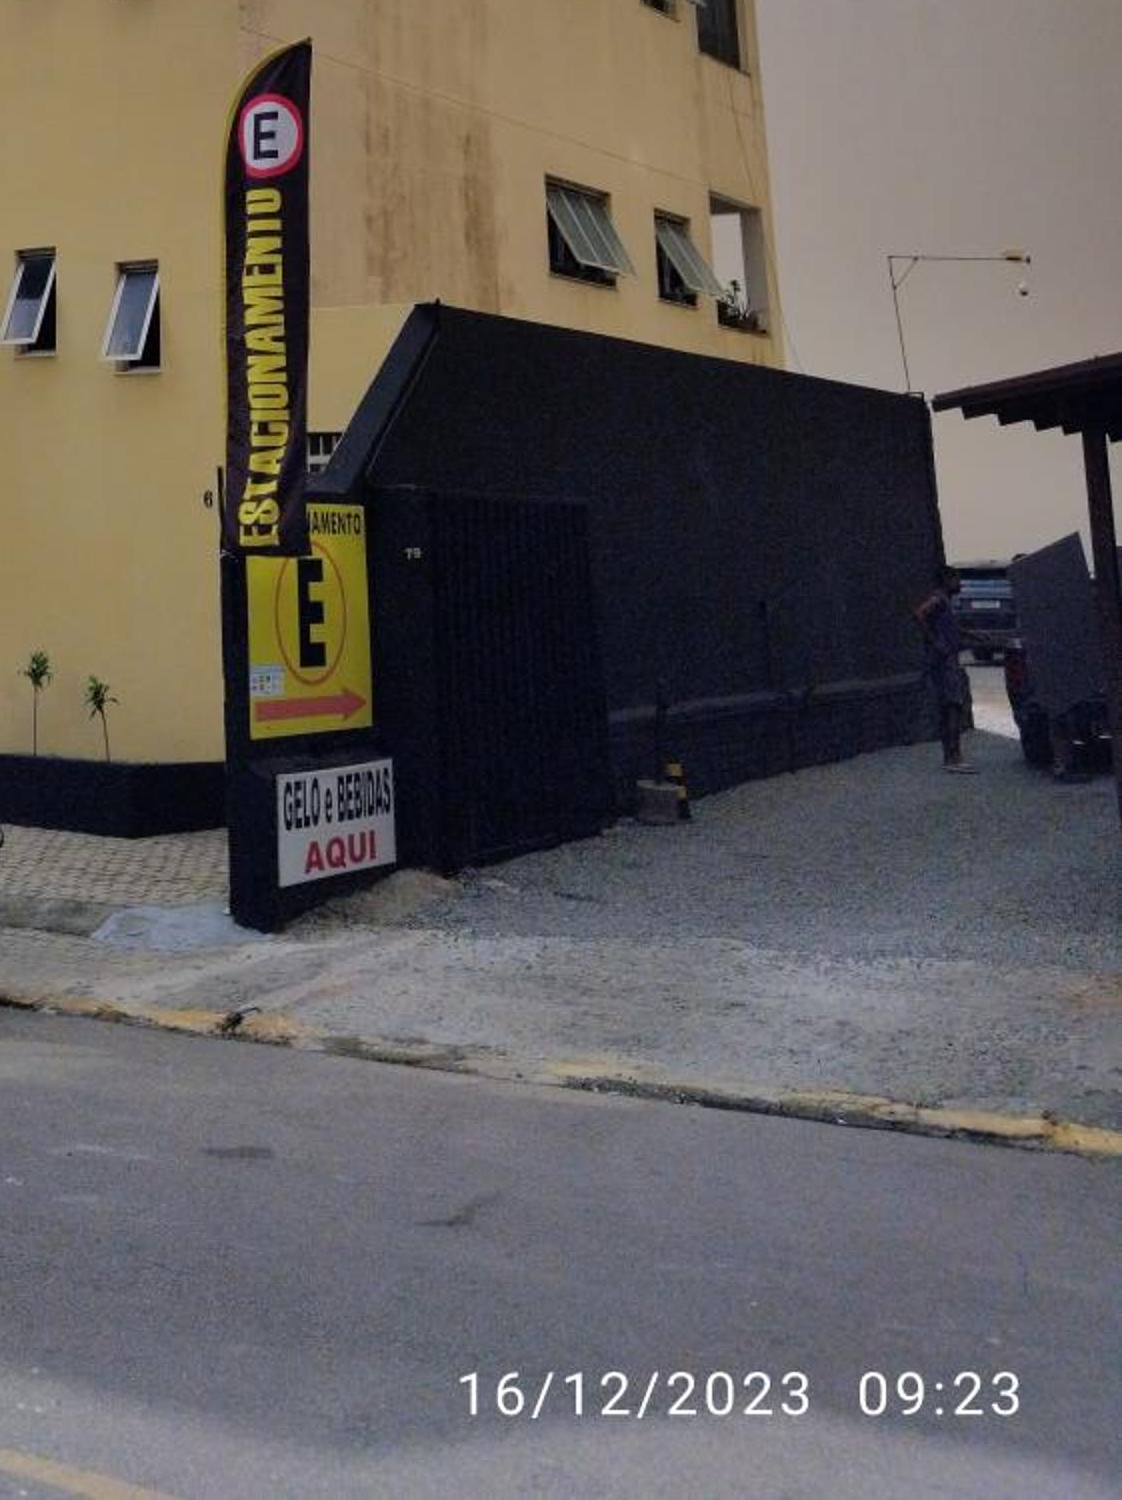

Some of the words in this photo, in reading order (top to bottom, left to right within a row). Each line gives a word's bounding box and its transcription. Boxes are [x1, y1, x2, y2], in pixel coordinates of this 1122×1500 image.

[253, 111, 280, 160] E
[307, 511, 361, 535] AMENTO
[297, 558, 327, 668] E
[283, 777, 320, 831] GELO
[325, 788, 333, 823] e
[337, 767, 391, 822] BEBIDAS
[305, 830, 377, 875] AQUI
